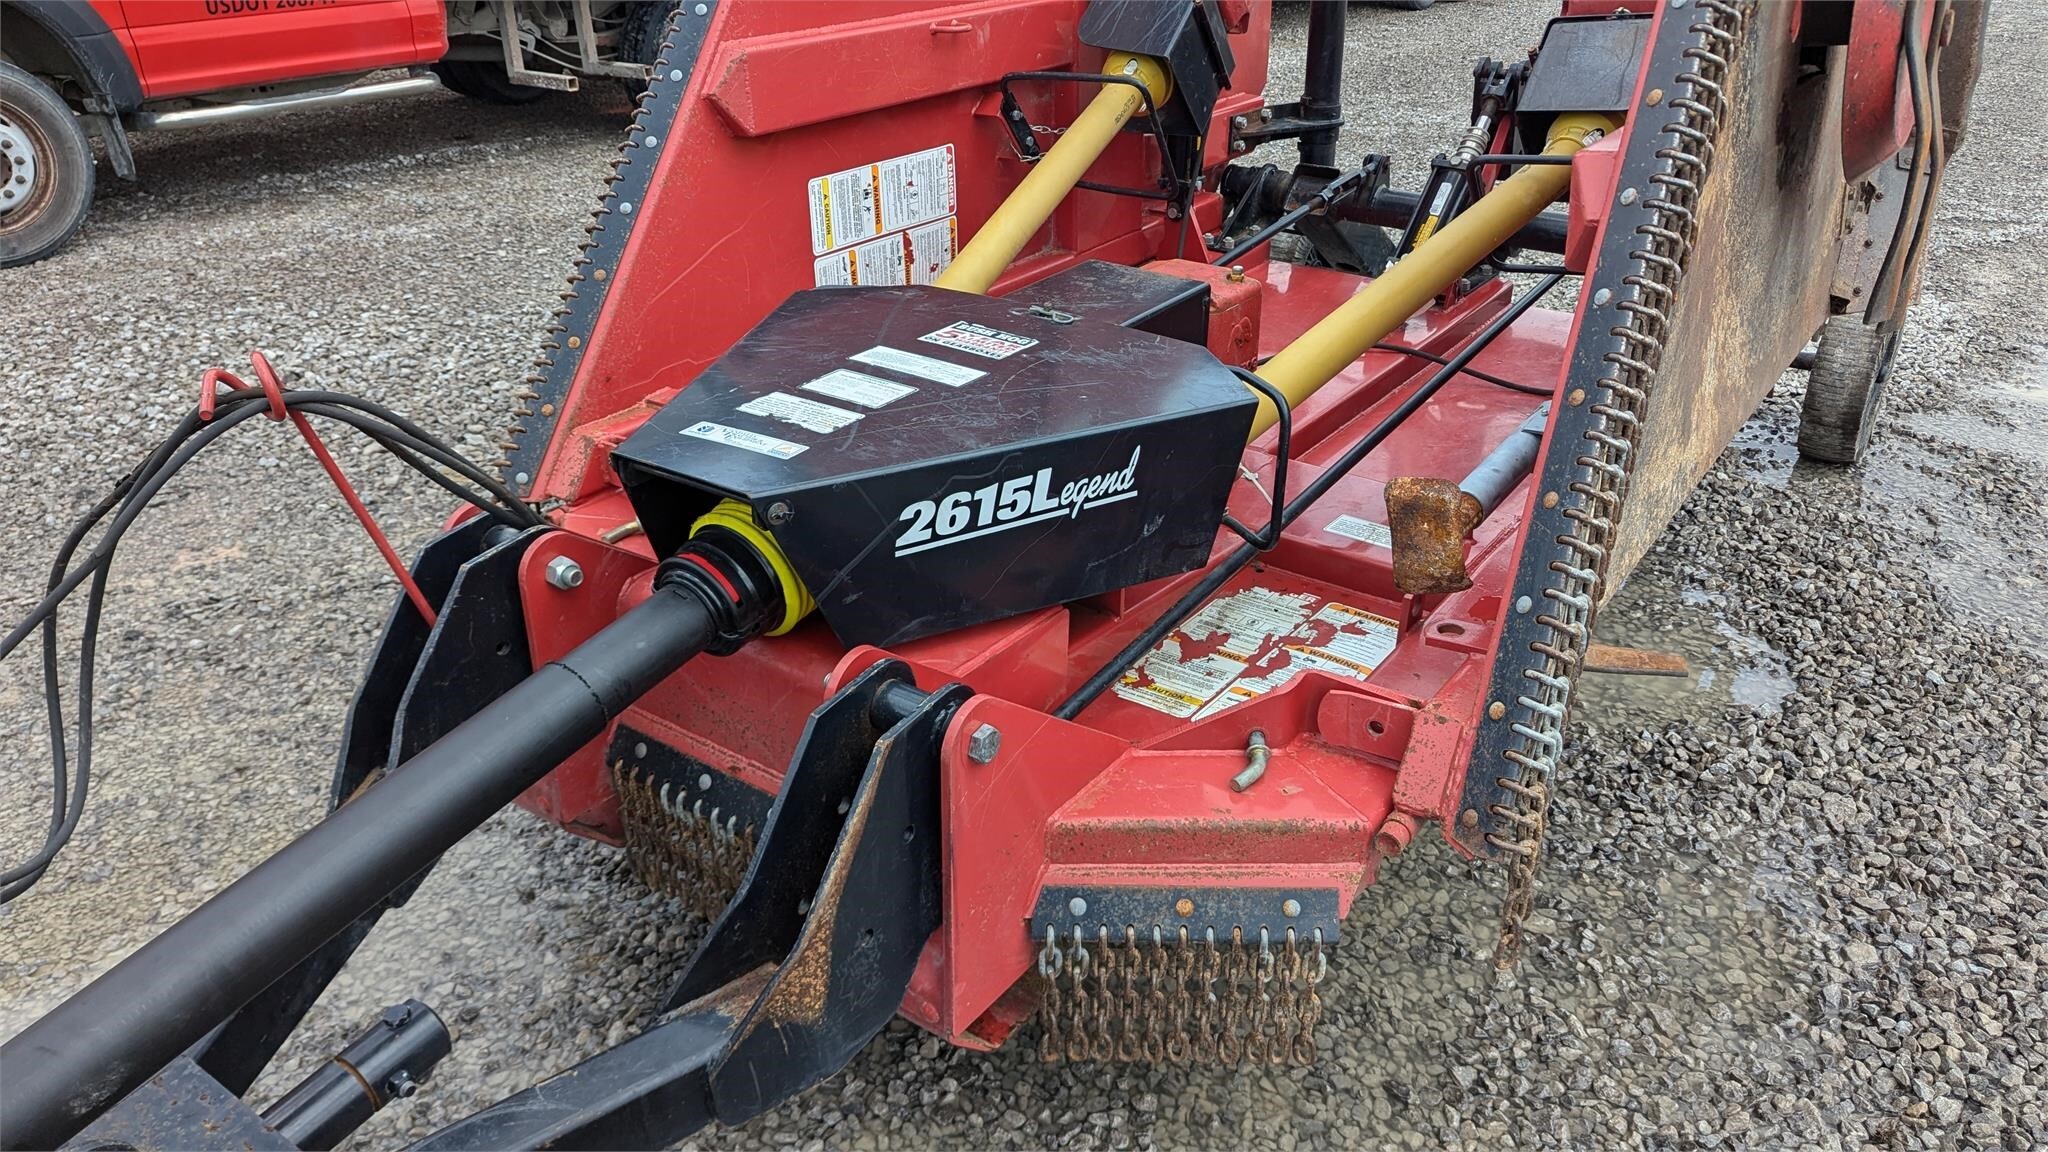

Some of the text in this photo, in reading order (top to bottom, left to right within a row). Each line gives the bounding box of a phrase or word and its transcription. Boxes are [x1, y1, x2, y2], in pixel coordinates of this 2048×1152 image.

[947, 165, 955, 207] DANGER
[872, 185, 881, 225] WARNING
[824, 203, 832, 236] CAUTION
[957, 324, 1030, 345] BUSH HOG
[942, 341, 1001, 357] GEARBOXES
[1309, 649, 1360, 671] WARNING
[1152, 685, 1184, 700] AUTION
